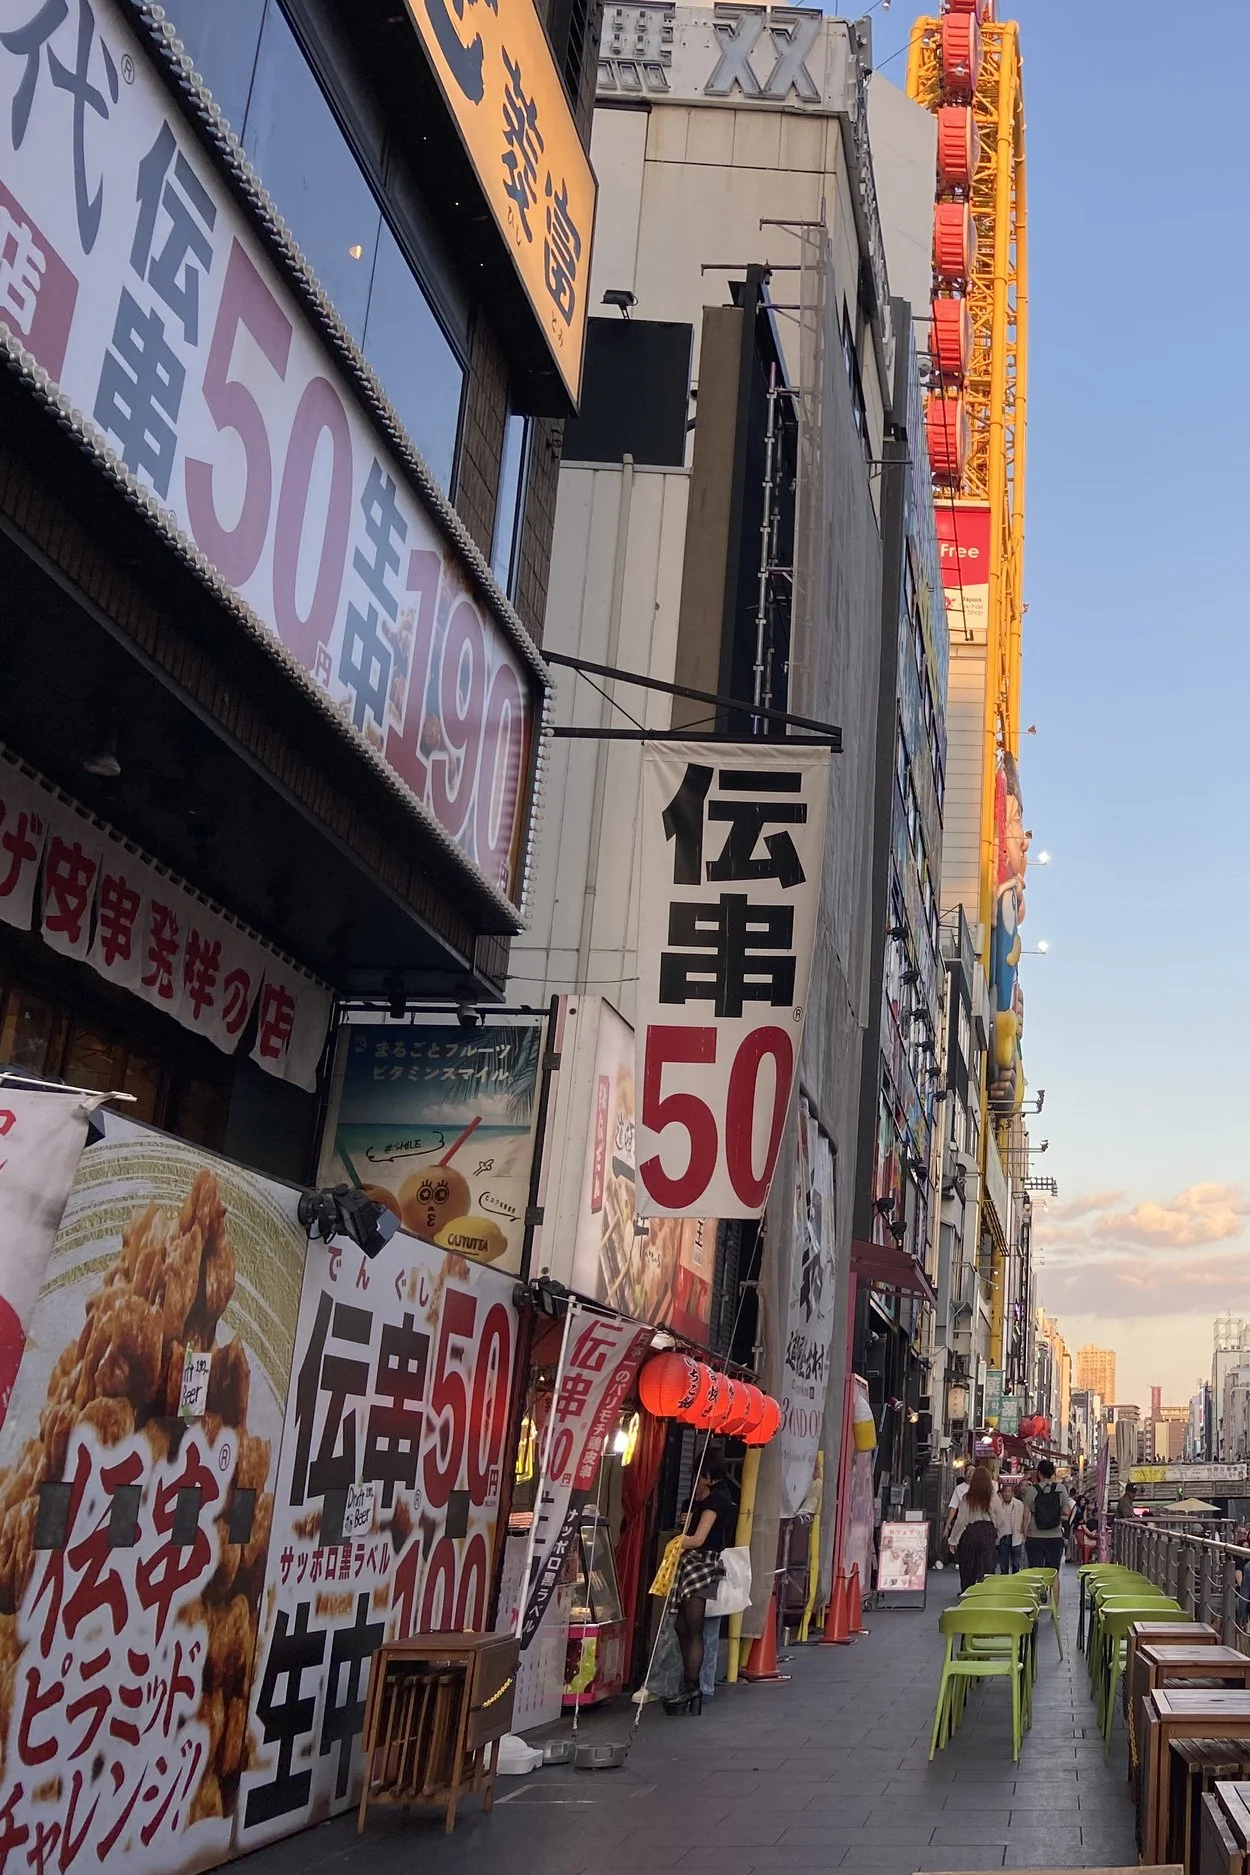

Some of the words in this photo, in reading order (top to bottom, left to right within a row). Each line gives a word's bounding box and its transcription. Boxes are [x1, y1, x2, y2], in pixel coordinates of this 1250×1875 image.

[185, 236, 352, 671] 50
[941, 543, 980, 559] Free
[386, 548, 525, 885] 190
[659, 762, 807, 1018] 伝串
[374, 1040, 512, 1059] まるごとフルーツ
[639, 1024, 794, 1210] 50
[328, 1246, 429, 1307] でんぐし
[289, 1289, 430, 1508] 伝串
[423, 1287, 511, 1507] 50
[557, 1319, 623, 1422] 伝串
[36, 1441, 222, 1659] 伝串
[280, 1541, 391, 1587] サッポロ黒ラベル
[354, 1508, 371, 1528] Beer
[522, 1508, 579, 1632] サッポロ黒ラベル
[18, 1640, 201, 1766] ピラミッド
